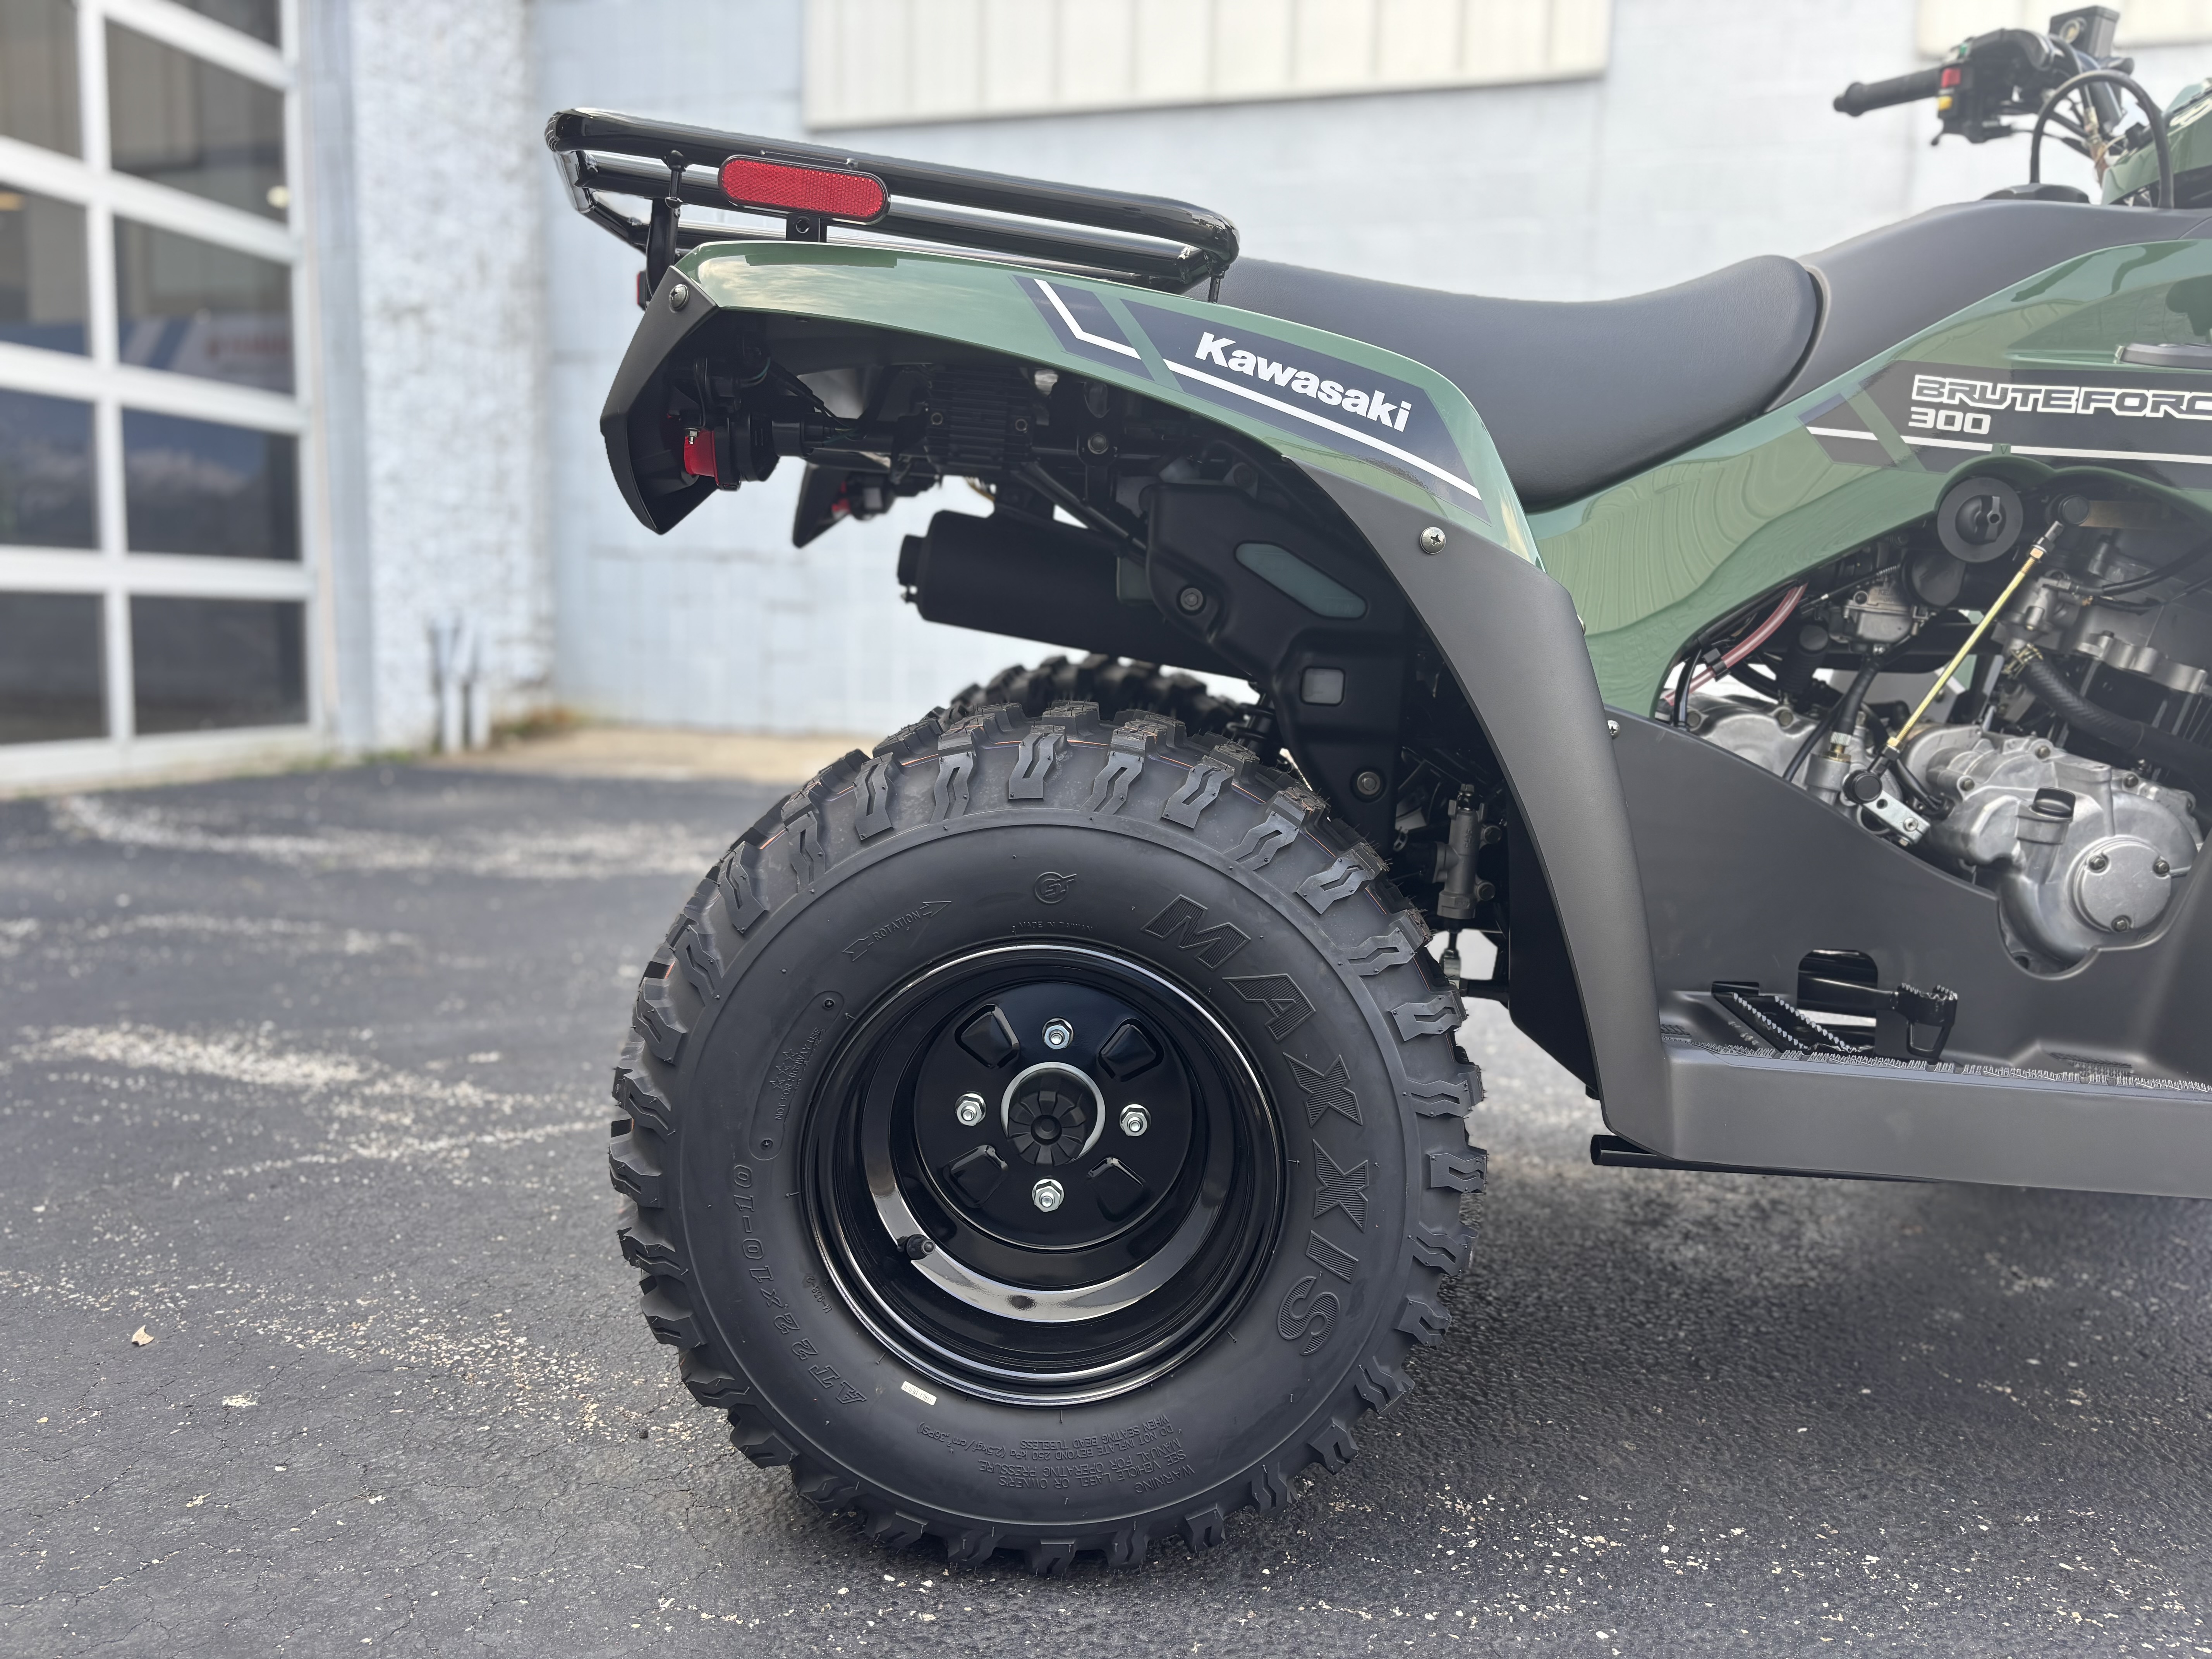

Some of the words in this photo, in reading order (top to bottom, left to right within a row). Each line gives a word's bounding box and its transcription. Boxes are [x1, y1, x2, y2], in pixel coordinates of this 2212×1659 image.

[1195, 332, 1411, 432] Kawasaki
[1908, 407, 1991, 434] 300
[872, 910, 921, 940] ROTATION
[1059, 922, 1093, 931] TAAN
[775, 1103, 786, 1120] NOT
[781, 1083, 792, 1100] FOR
[788, 1044, 811, 1082] HIGHWAY
[1140, 894, 1369, 1356] MAXXIS
[1143, 1414, 1170, 1432] WHEN
[1160, 1423, 1174, 1437] DO
[1073, 1436, 1099, 1448] BEAD
[1101, 1425, 1140, 1444] SEATING
[1139, 1431, 1158, 1445] NOT
[1020, 1439, 1069, 1450] TUBELESS
[1097, 1438, 1135, 1456] INFLATE
[1137, 1438, 1182, 1462] MANUAL
[1032, 1451, 1051, 1460] 250
[1055, 1448, 1094, 1460] BEYOND
[1164, 1449, 1186, 1465] SEE
[1043, 1462, 1104, 1477] OPERATING
[1109, 1455, 1133, 1470] FOR
[1116, 1460, 1161, 1481] VEHICLE
[1054, 1477, 1070, 1488] OR
[1075, 1472, 1112, 1486] LABEL
[1135, 1464, 1195, 1493] WARNING
